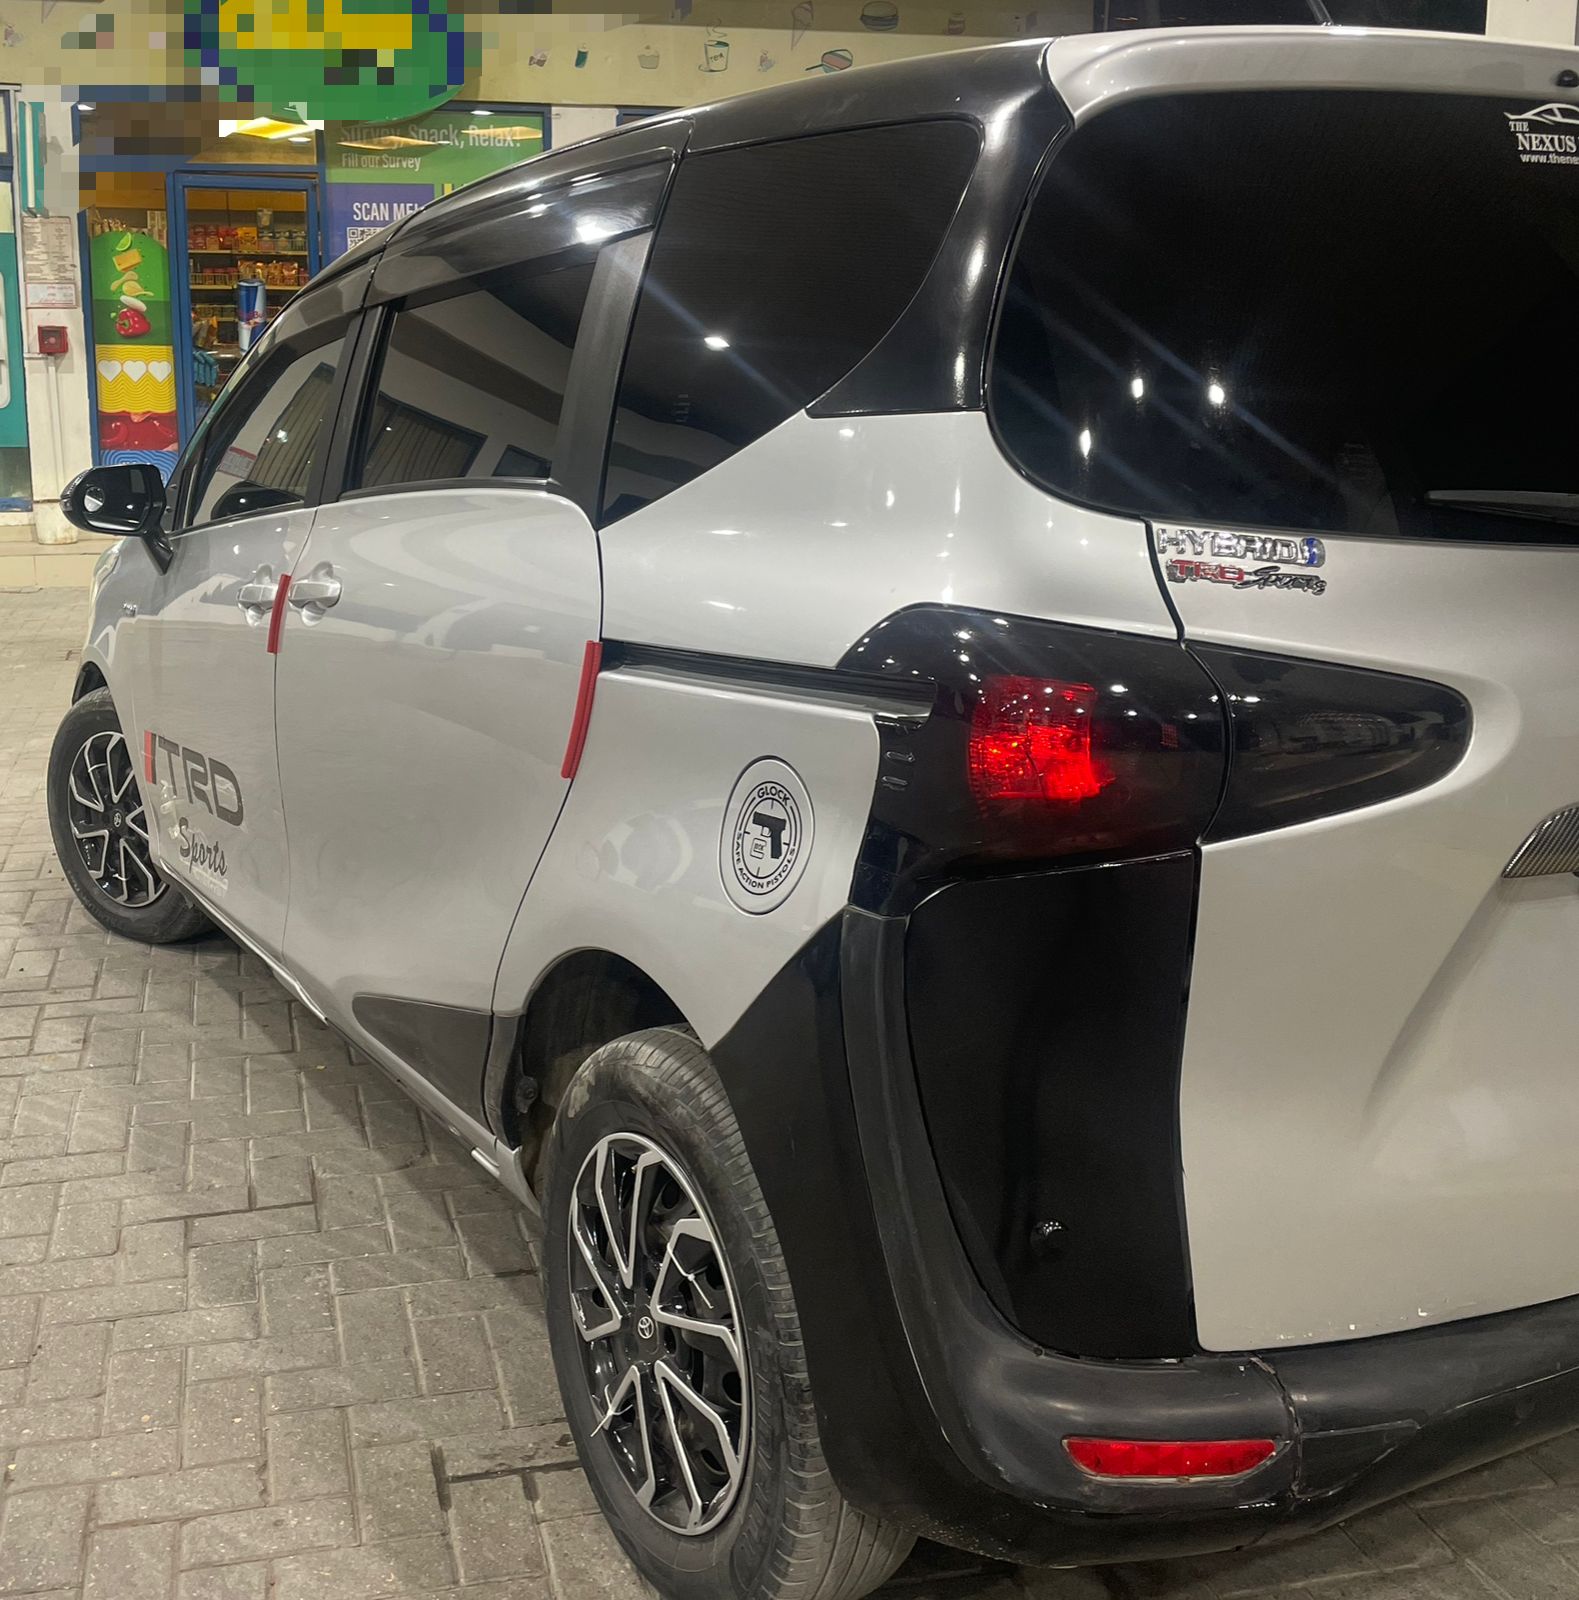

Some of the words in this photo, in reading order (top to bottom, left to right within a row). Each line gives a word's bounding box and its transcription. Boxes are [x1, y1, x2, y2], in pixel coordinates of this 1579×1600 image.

[468, 124, 521, 147] Relax!
[1508, 120, 1529, 132] THE
[1515, 133, 1577, 153] NEXUS
[342, 153, 360, 168] Fill
[360, 155, 380, 168] our
[381, 154, 421, 172] Survey
[352, 202, 390, 221] SCAN
[1157, 527, 1298, 563] HYBRID
[1166, 558, 1245, 584] TRD
[1233, 566, 1328, 596] Sports
[157, 735, 244, 827] TRD
[756, 785, 791, 808] GLOCK
[178, 816, 228, 877] Sports
[734, 832, 743, 865] SAFE
[738, 867, 765, 889] ACTION
[766, 847, 796, 888] PISTOLS
